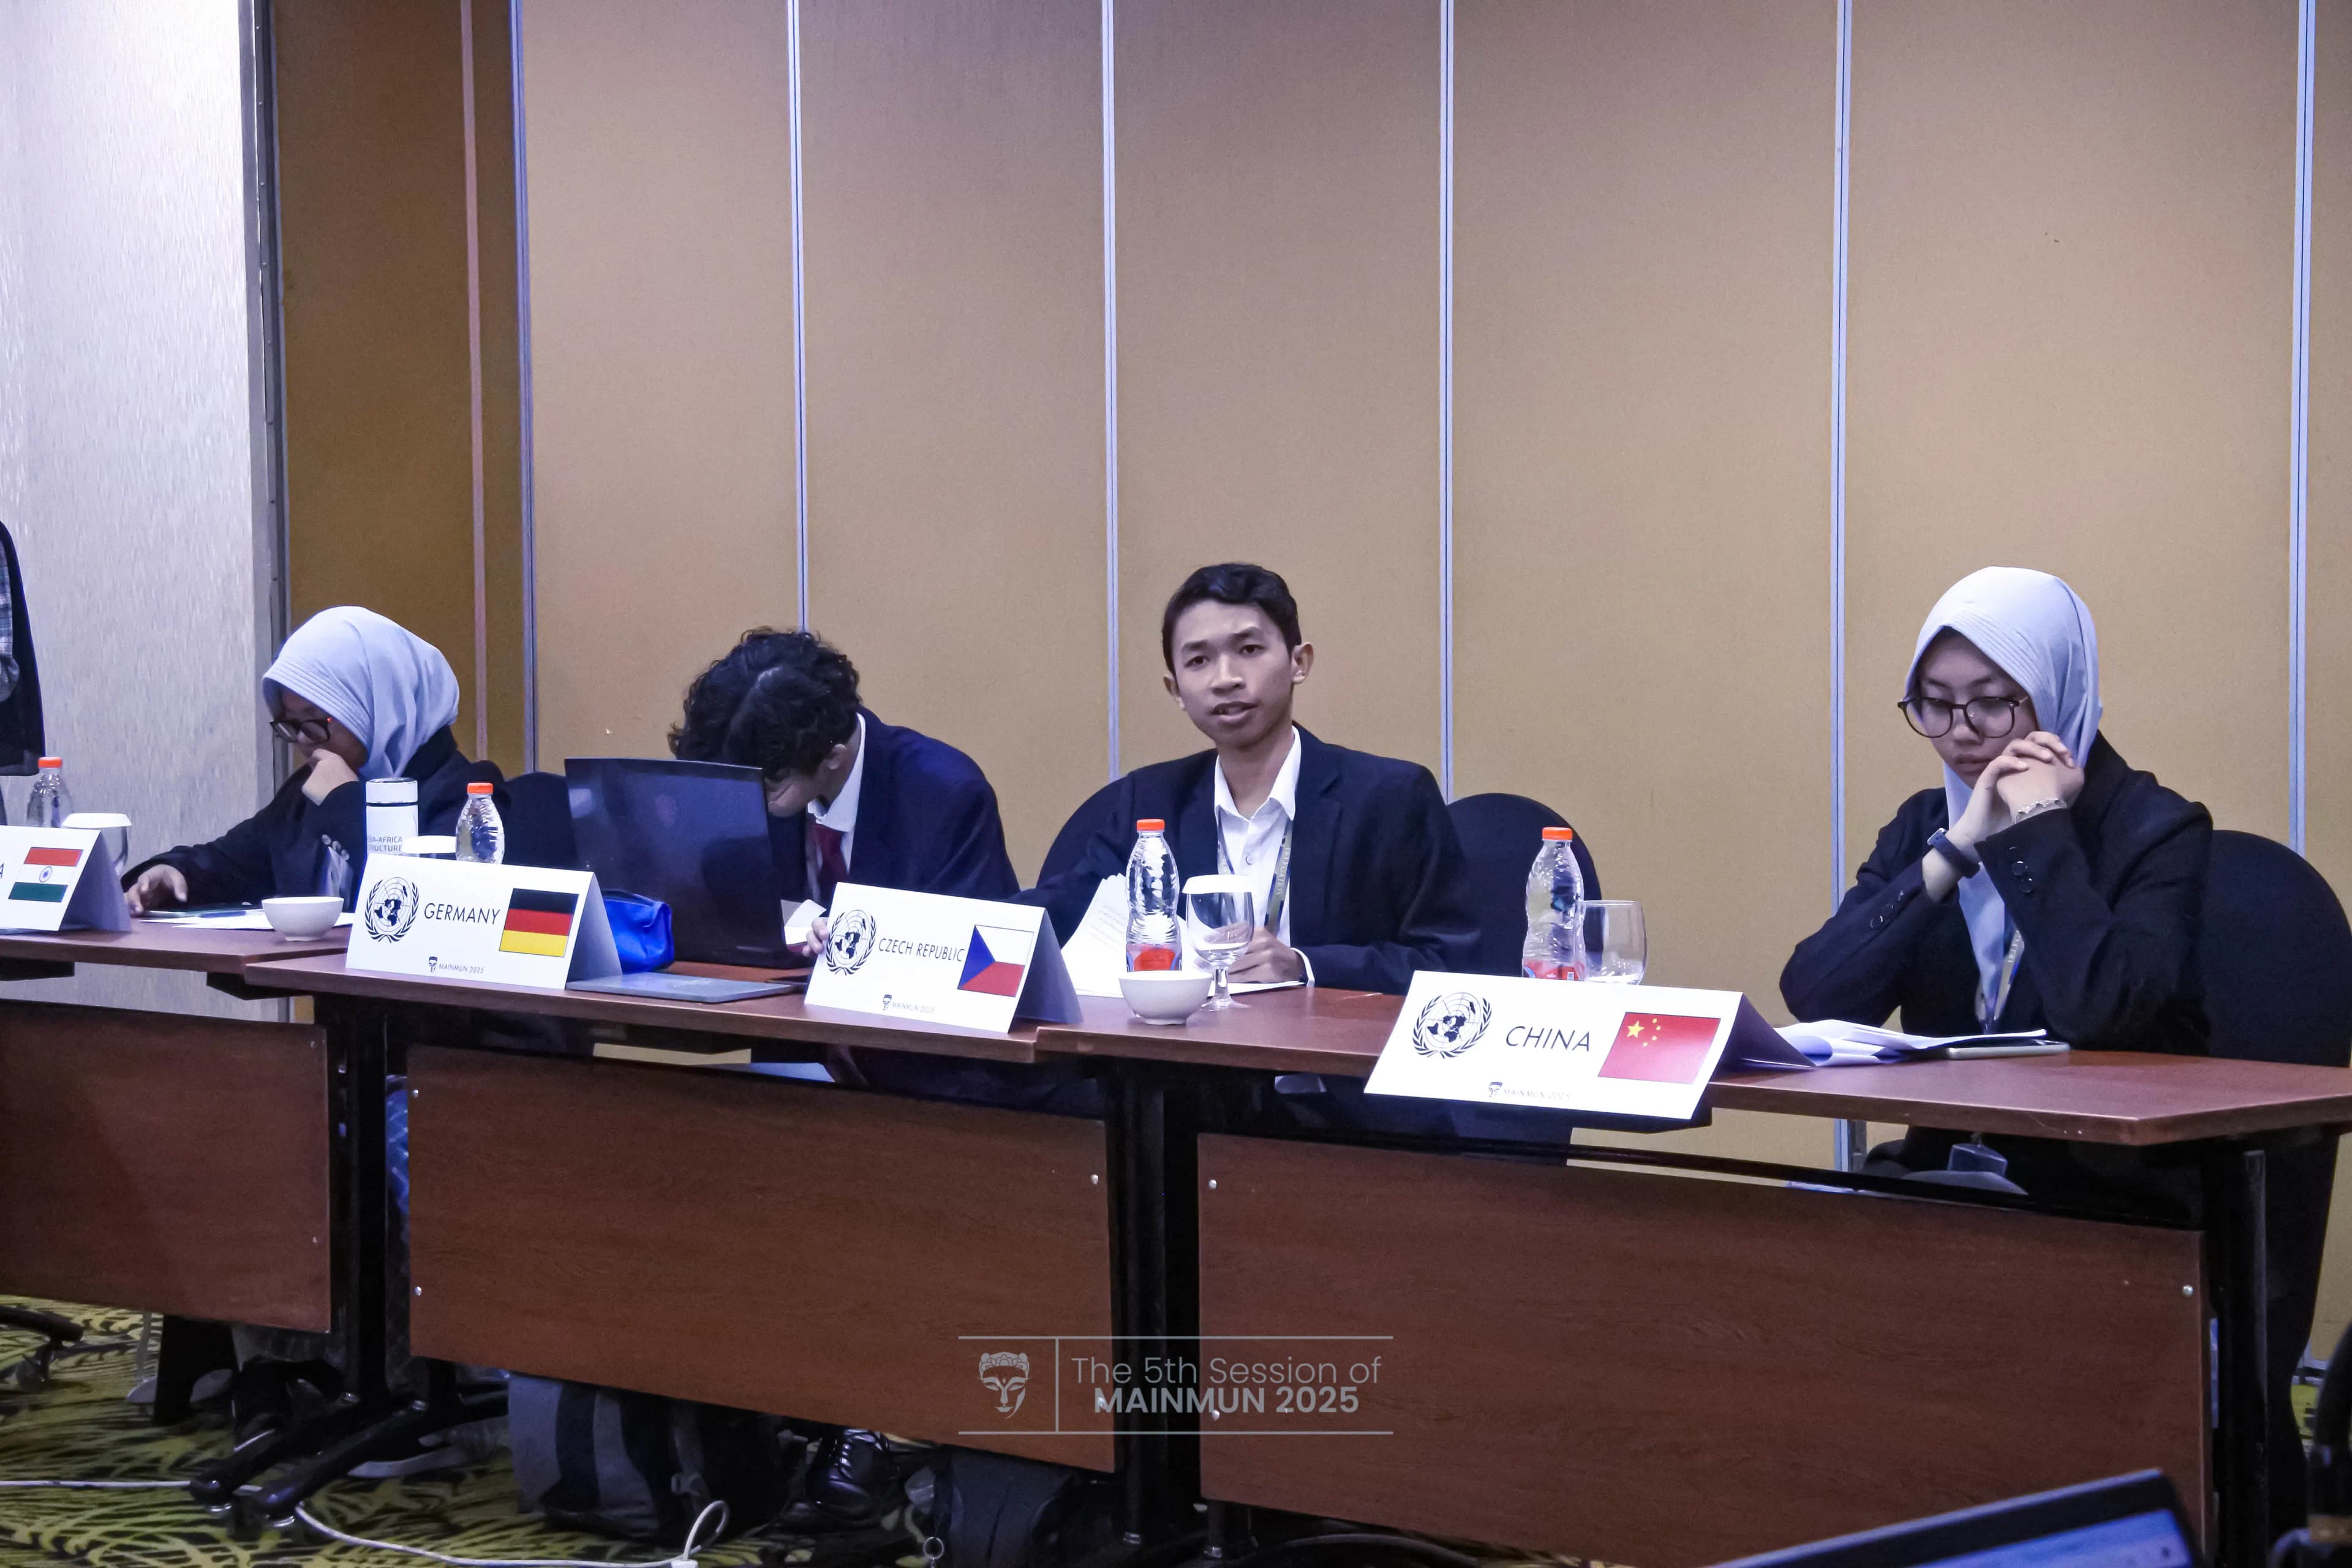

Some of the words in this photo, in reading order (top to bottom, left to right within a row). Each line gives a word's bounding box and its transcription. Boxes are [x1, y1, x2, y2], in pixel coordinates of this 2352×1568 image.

[424, 902, 500, 925] GERMANY
[878, 938, 914, 955] CZECH
[916, 943, 965, 962] REPUBLIC
[439, 963, 468, 972] MAINMUN
[1506, 1025, 1590, 1052] CHINA
